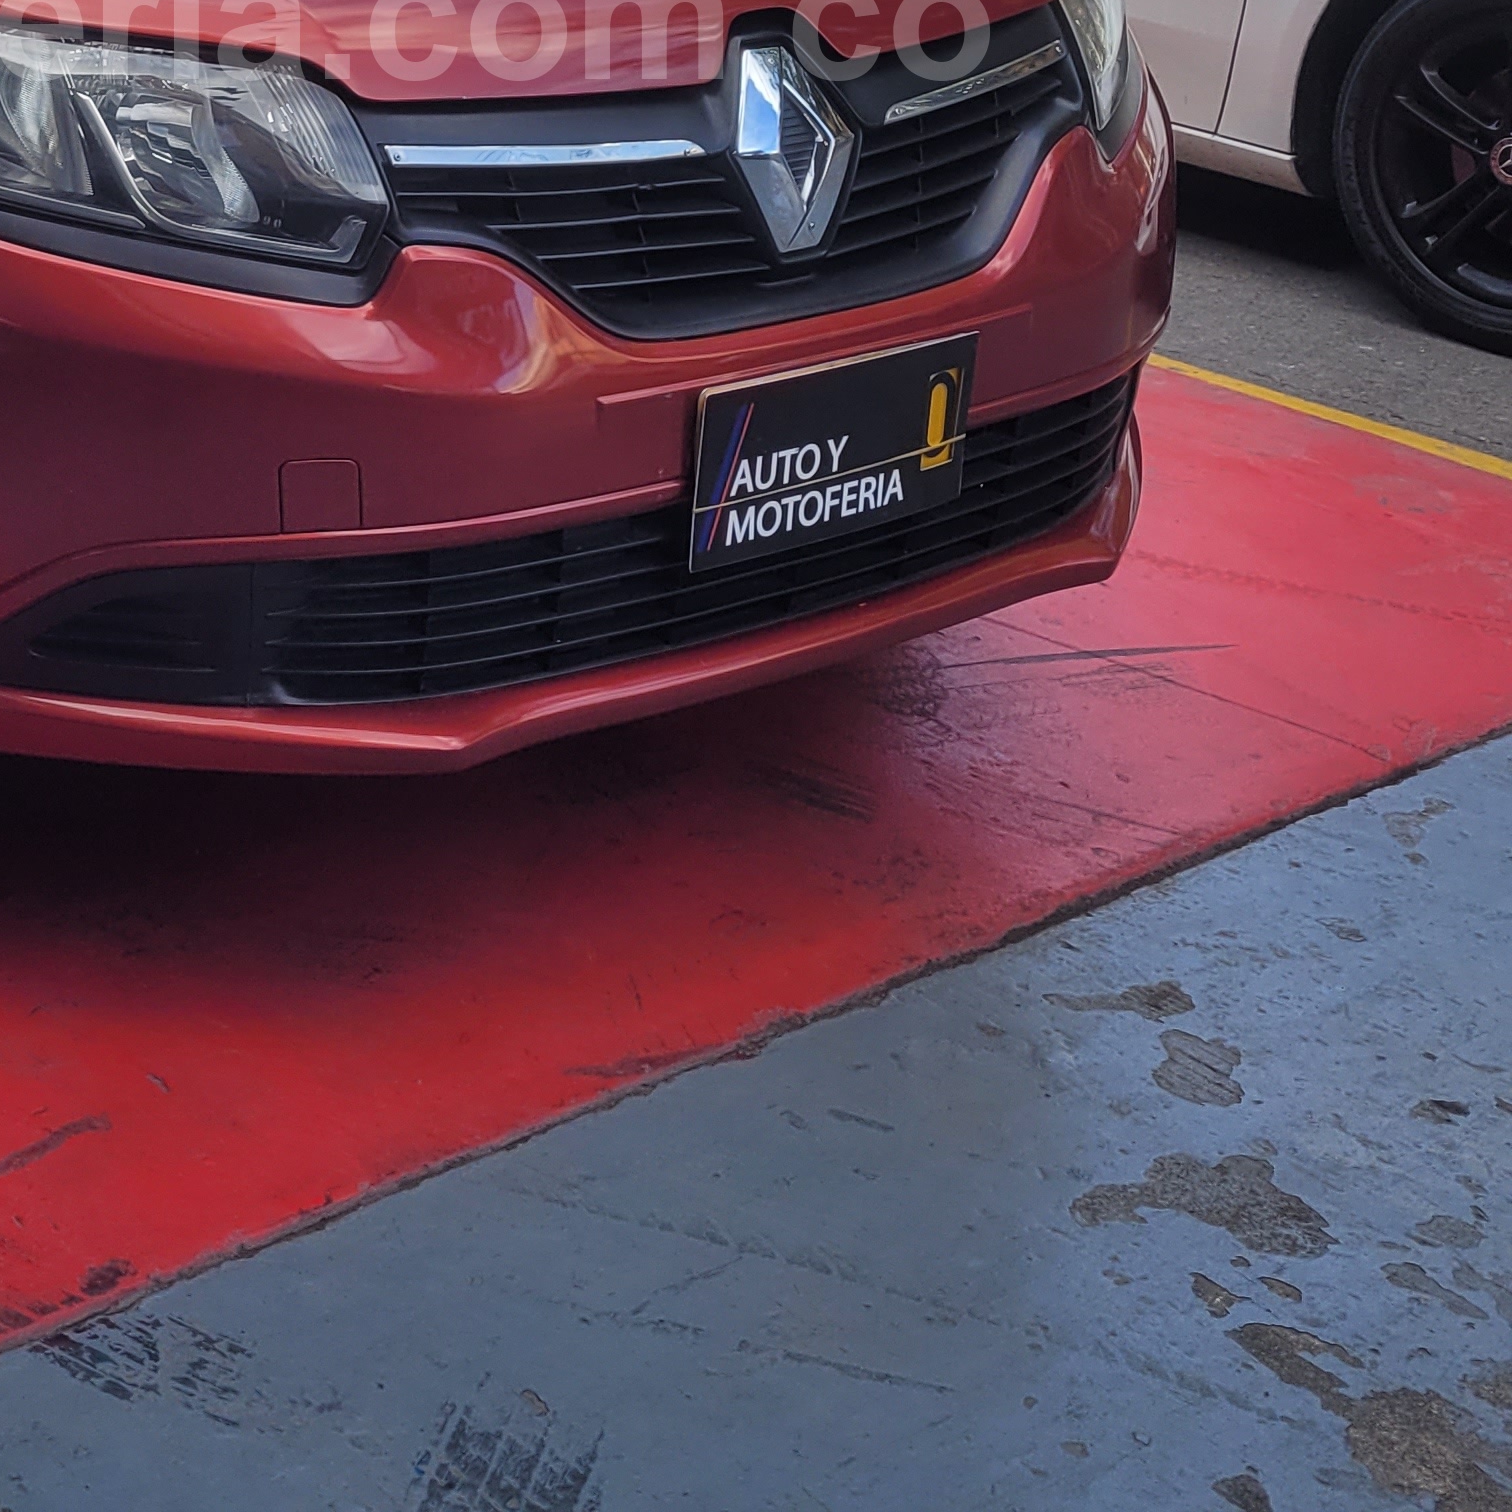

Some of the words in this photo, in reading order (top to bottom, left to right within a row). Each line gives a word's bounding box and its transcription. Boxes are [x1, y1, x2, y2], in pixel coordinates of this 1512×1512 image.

[729, 442, 821, 497] AUTO
[826, 435, 850, 473] Y
[724, 468, 905, 547] MOTOFERIA
